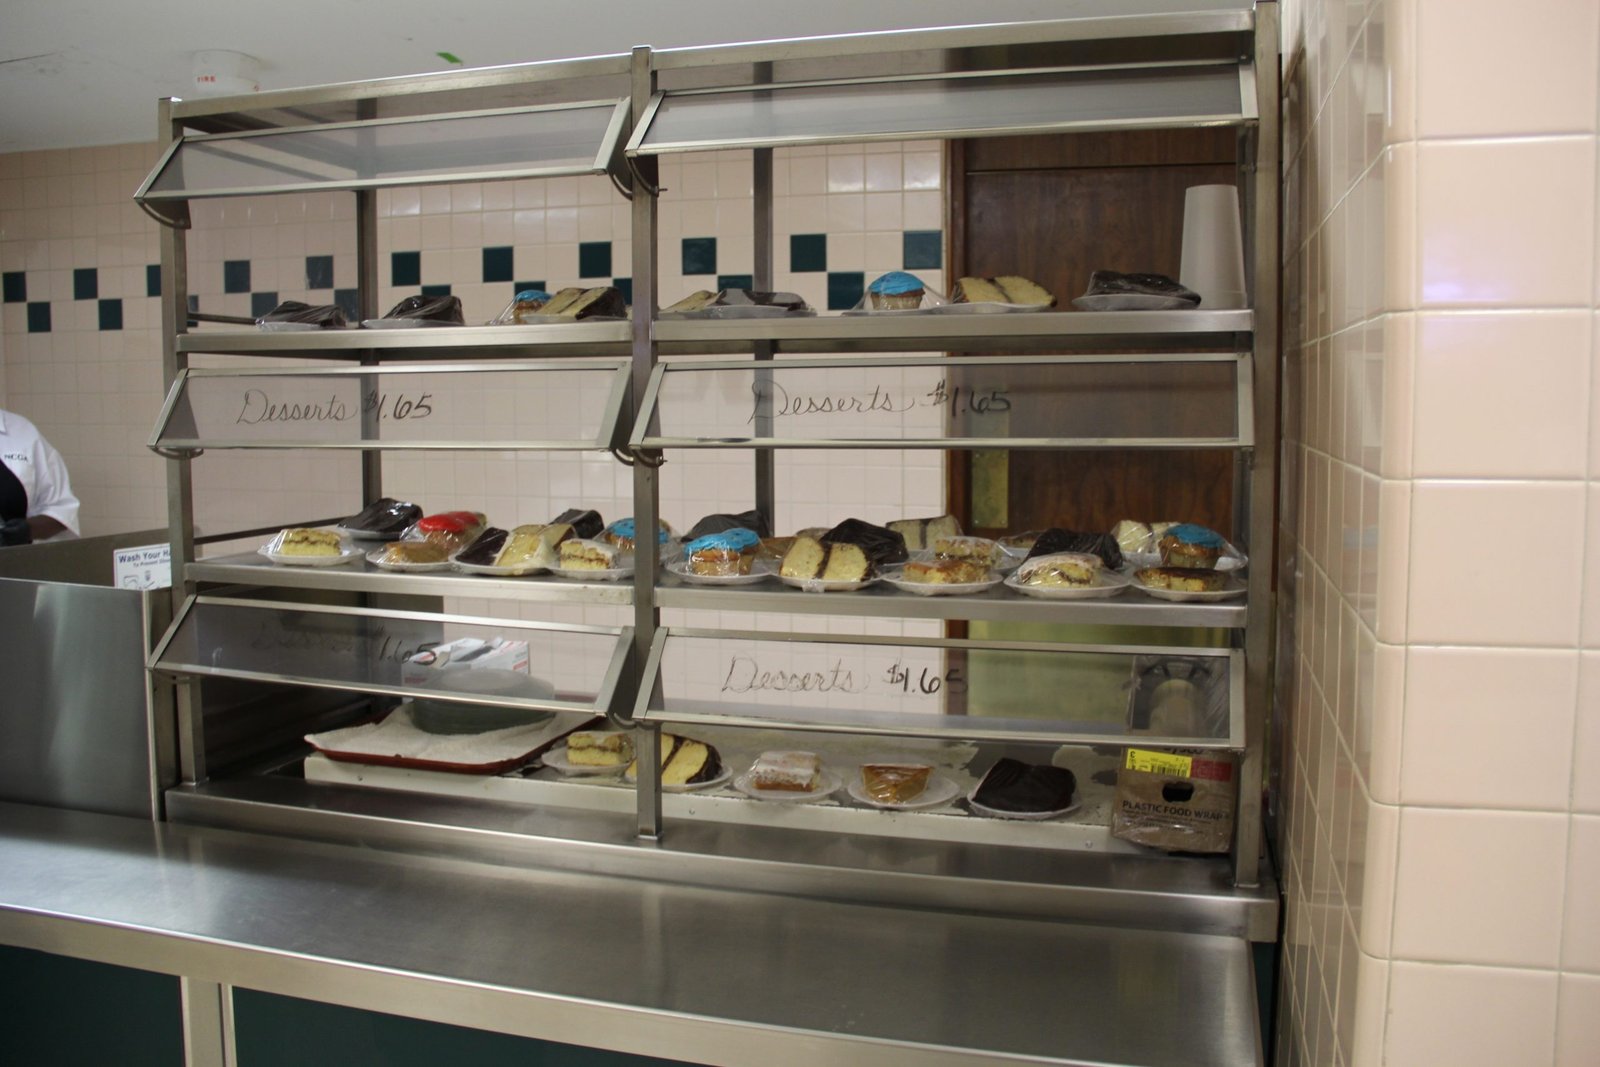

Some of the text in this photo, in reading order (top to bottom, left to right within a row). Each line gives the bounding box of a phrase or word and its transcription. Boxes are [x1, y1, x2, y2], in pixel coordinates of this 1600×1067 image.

[236, 389, 432, 424] Desserts $1.65
[748, 379, 1011, 424] Desserts $1.65
[118, 553, 141, 563] Wash
[143, 551, 161, 560] Your
[721, 655, 968, 694] Desserts $1.65
[1122, 799, 1224, 821] PLASTIC FOOD WRAP
